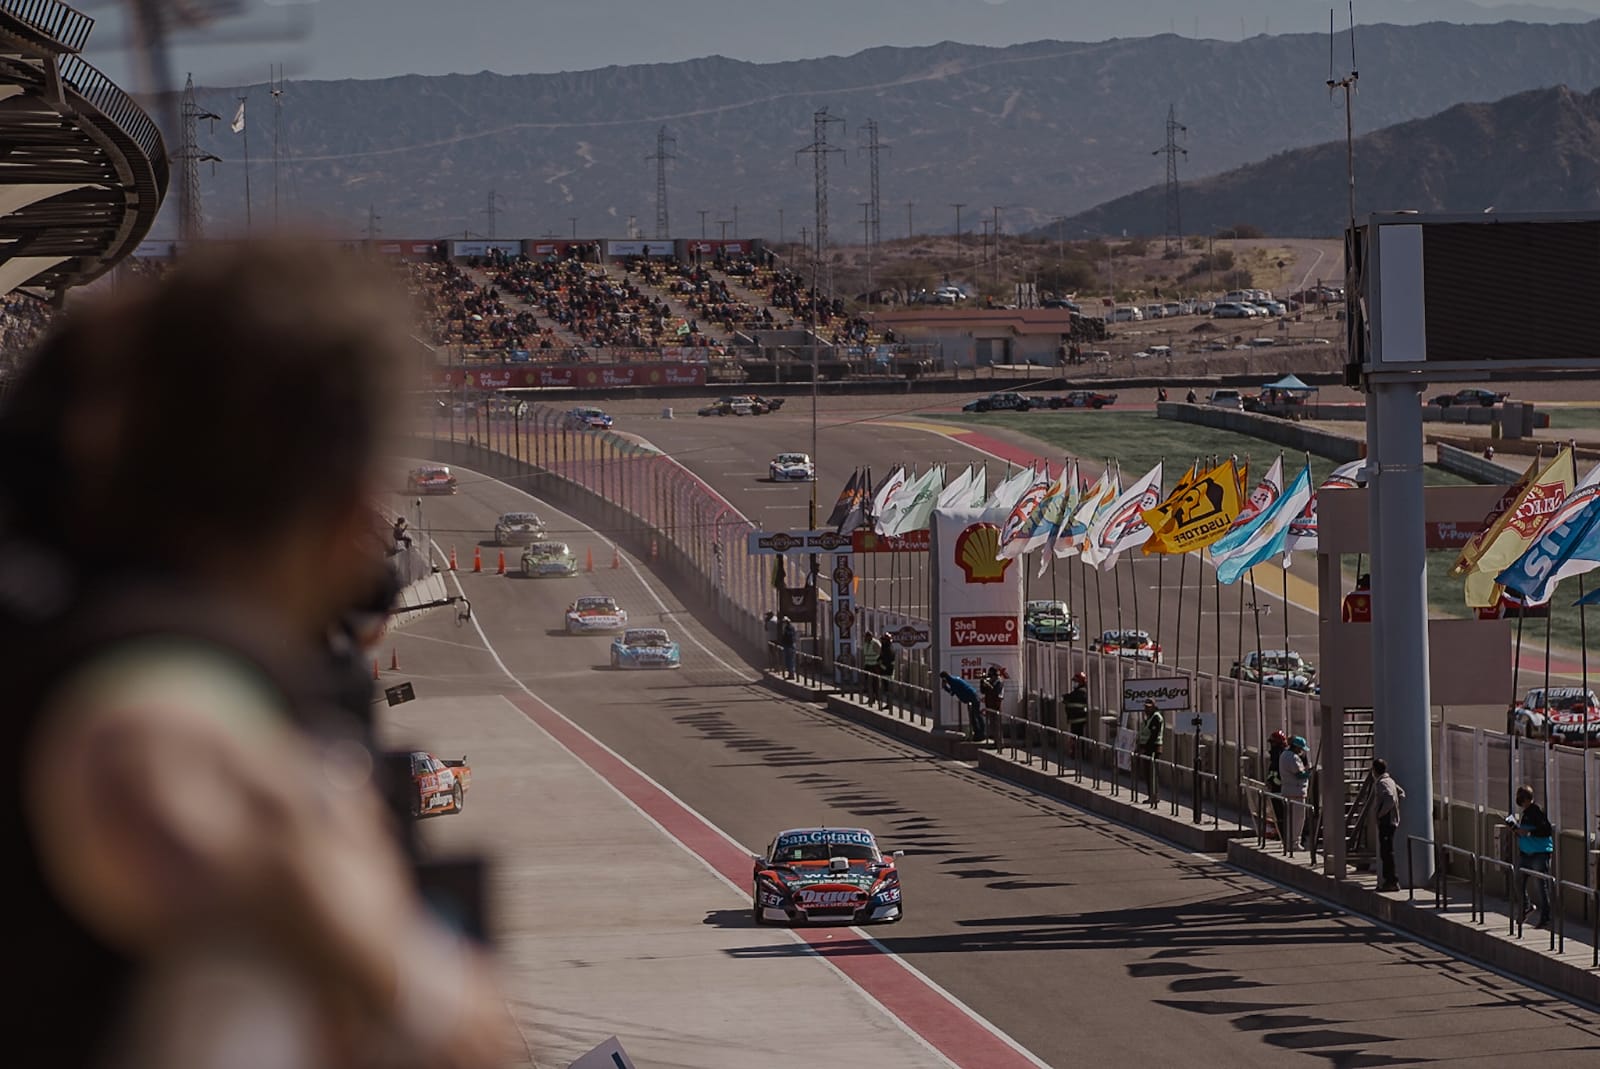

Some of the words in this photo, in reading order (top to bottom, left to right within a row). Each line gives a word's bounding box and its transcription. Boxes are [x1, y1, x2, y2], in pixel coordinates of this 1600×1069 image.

[954, 620, 976, 630] Shell
[955, 631, 1011, 643] V-Power
[961, 657, 982, 667] Shell
[961, 668, 1010, 680] HEX
[1124, 687, 1189, 701] SpeedAgro
[781, 836, 808, 846] San
[811, 832, 871, 844] Gotardo
